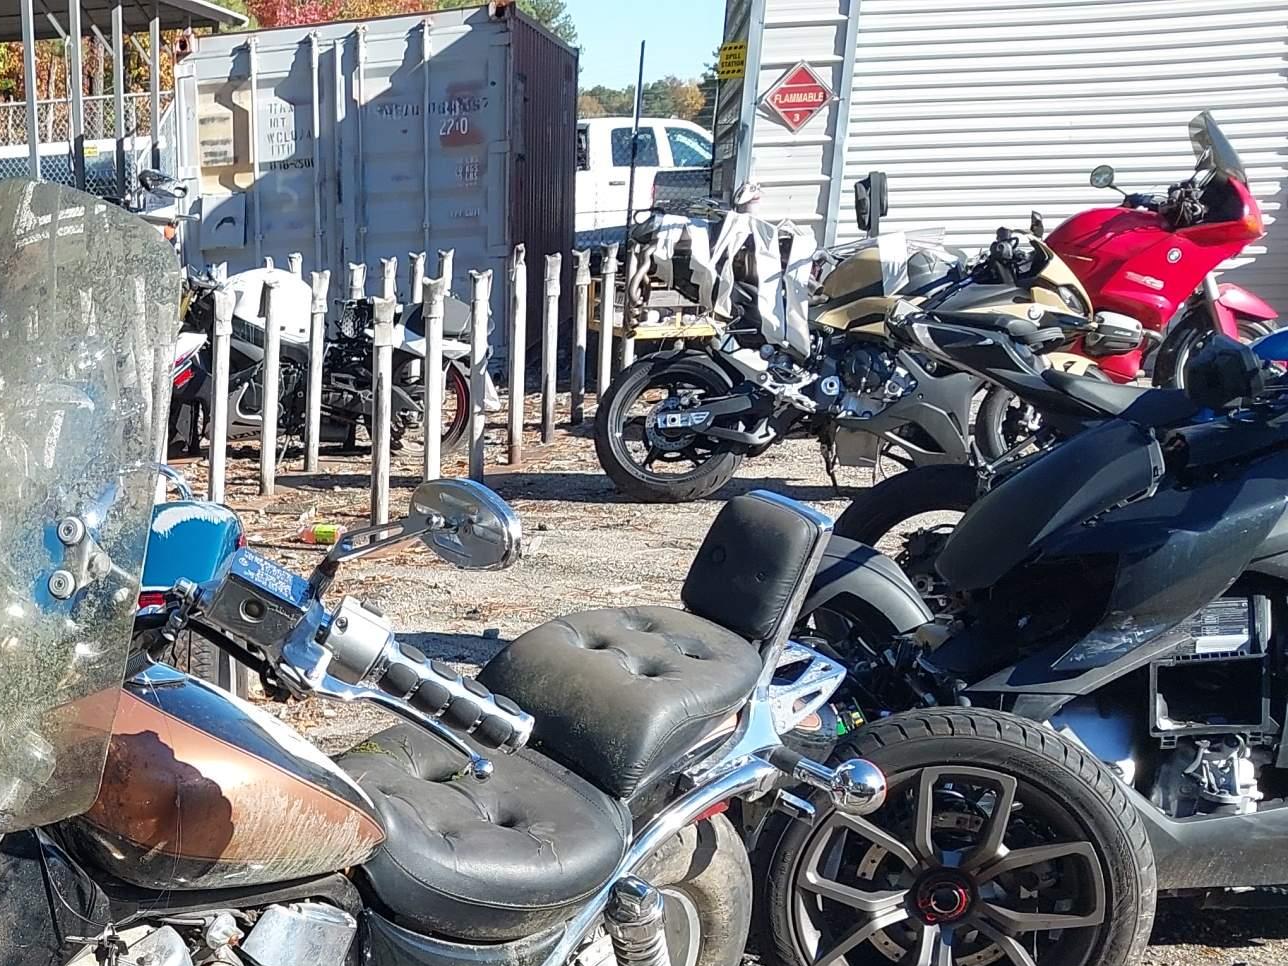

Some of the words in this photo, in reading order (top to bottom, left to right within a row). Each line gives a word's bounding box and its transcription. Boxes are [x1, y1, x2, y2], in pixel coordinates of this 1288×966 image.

[721, 60, 744, 68] STATION
[773, 92, 824, 103] FLAMMABLE
[793, 113, 800, 122] 3
